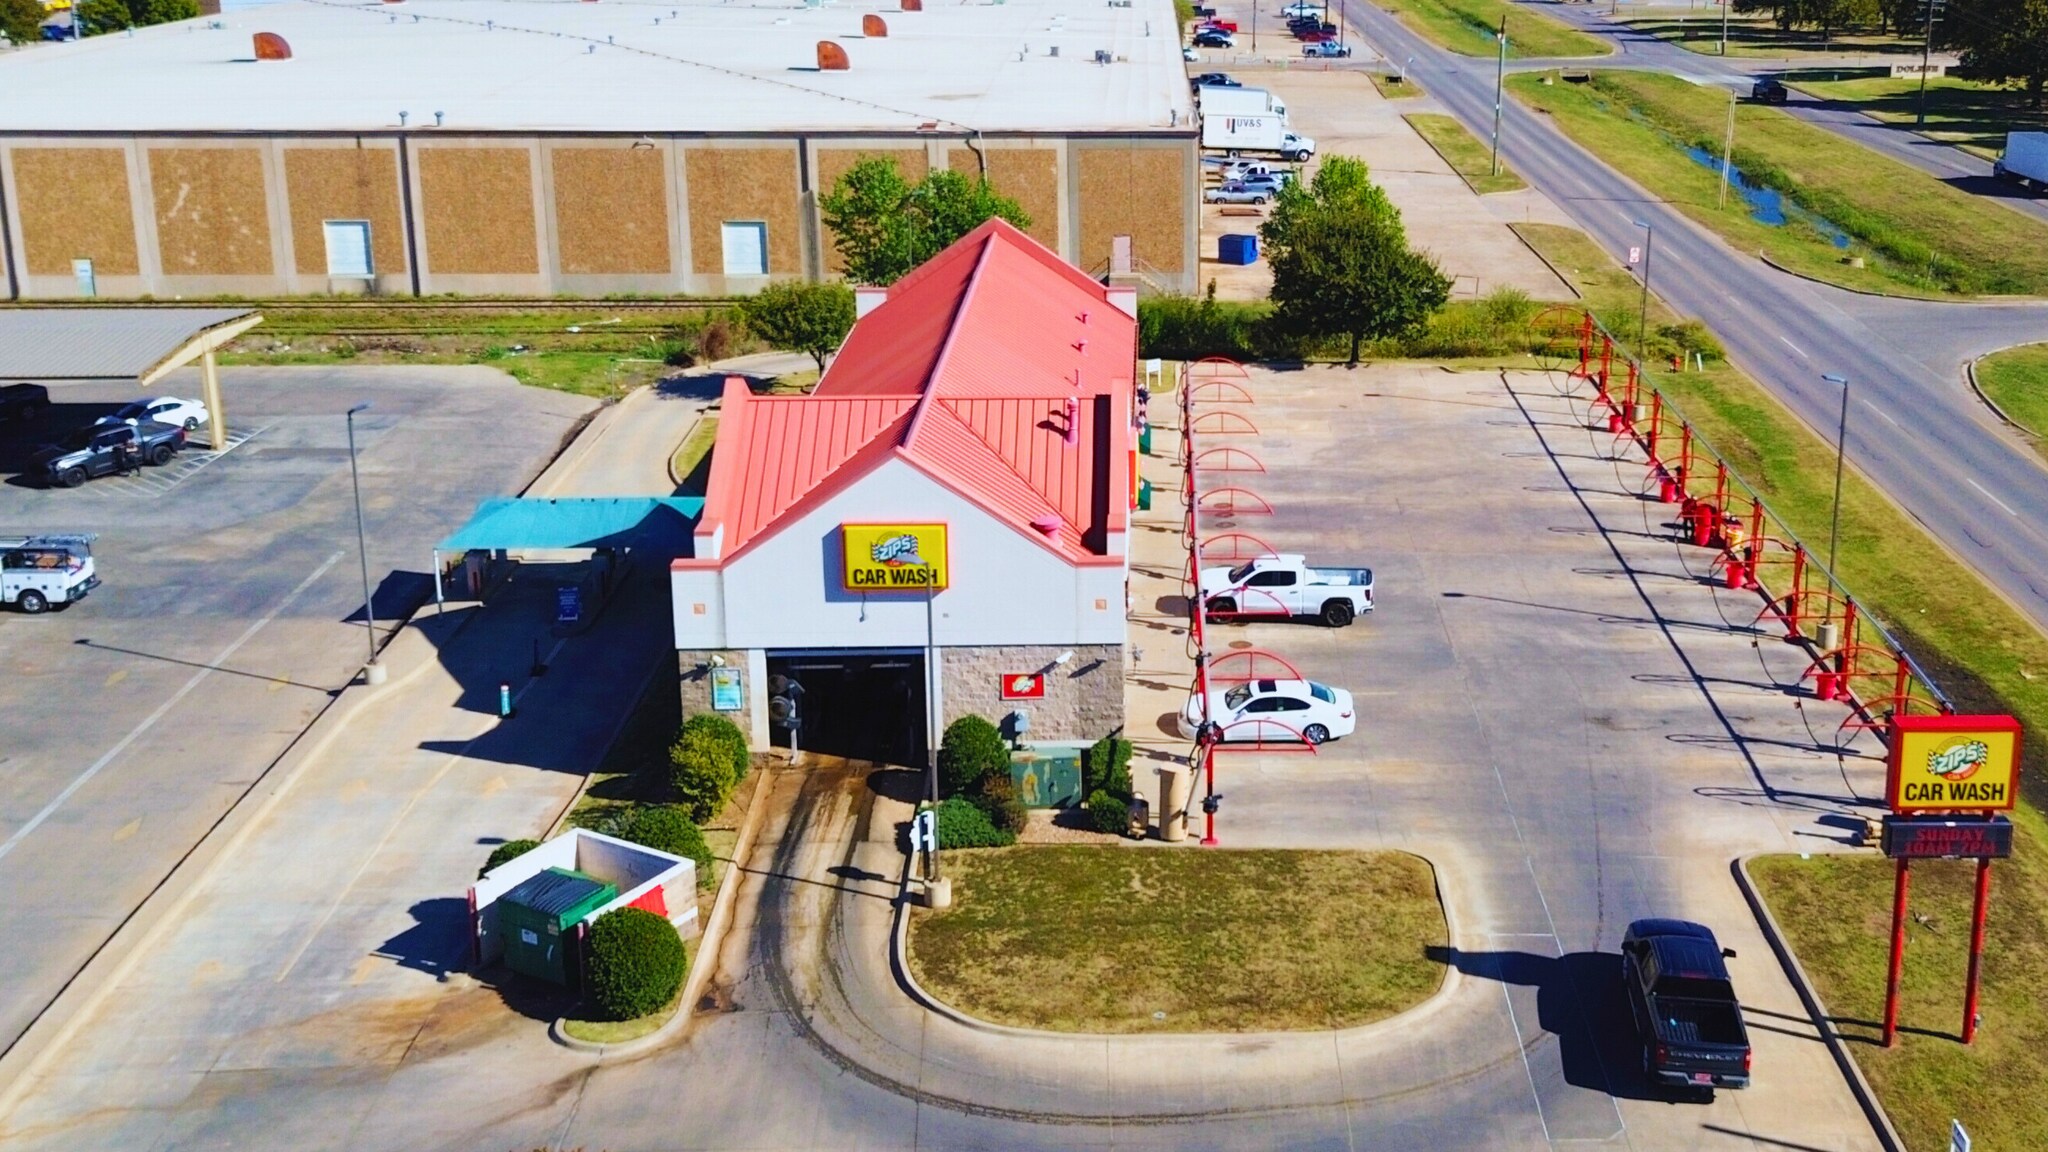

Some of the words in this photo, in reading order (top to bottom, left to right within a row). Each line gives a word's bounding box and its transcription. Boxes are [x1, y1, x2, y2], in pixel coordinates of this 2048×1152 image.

[1236, 118, 1262, 128] UV&S
[879, 537, 911, 560] ZIPS
[853, 568, 886, 584] CAR
[890, 568, 938, 584] WASH
[1936, 743, 1979, 774] ZIPS
[1905, 783, 1943, 801] CAR
[1949, 783, 2004, 801] WASH
[1916, 828, 1985, 841] SUNDAY
